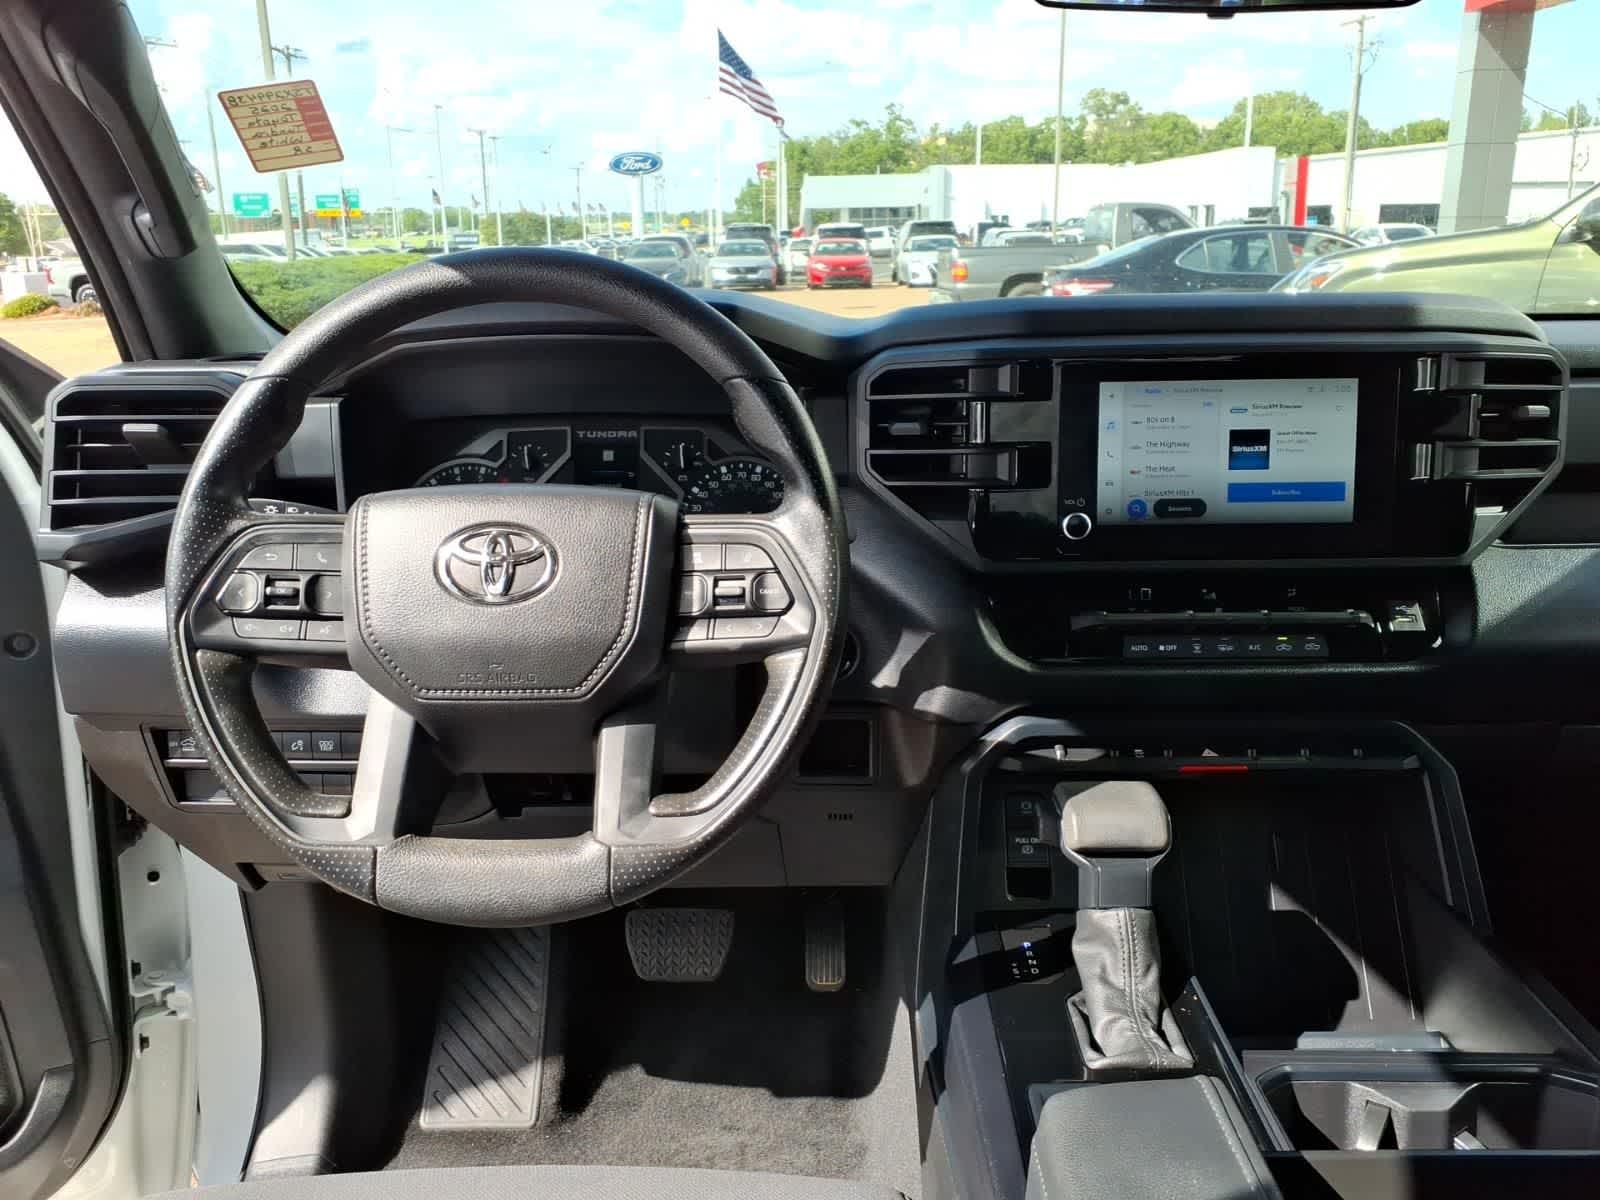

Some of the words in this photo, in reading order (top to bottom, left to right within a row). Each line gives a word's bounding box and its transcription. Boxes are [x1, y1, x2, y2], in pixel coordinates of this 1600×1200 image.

[620, 156, 652, 171] Ford
[576, 430, 638, 439] TUNDRA
[1160, 440, 1190, 448] Highway
[1232, 446, 1268, 454] SiriusXM
[737, 471, 747, 479] 70
[708, 481, 719, 489] 50
[698, 490, 708, 498] 40
[1144, 488, 1174, 496] SiriusXM
[692, 503, 702, 512] 30
[456, 673, 482, 684] SRS
[487, 673, 536, 685] AIRBAG
